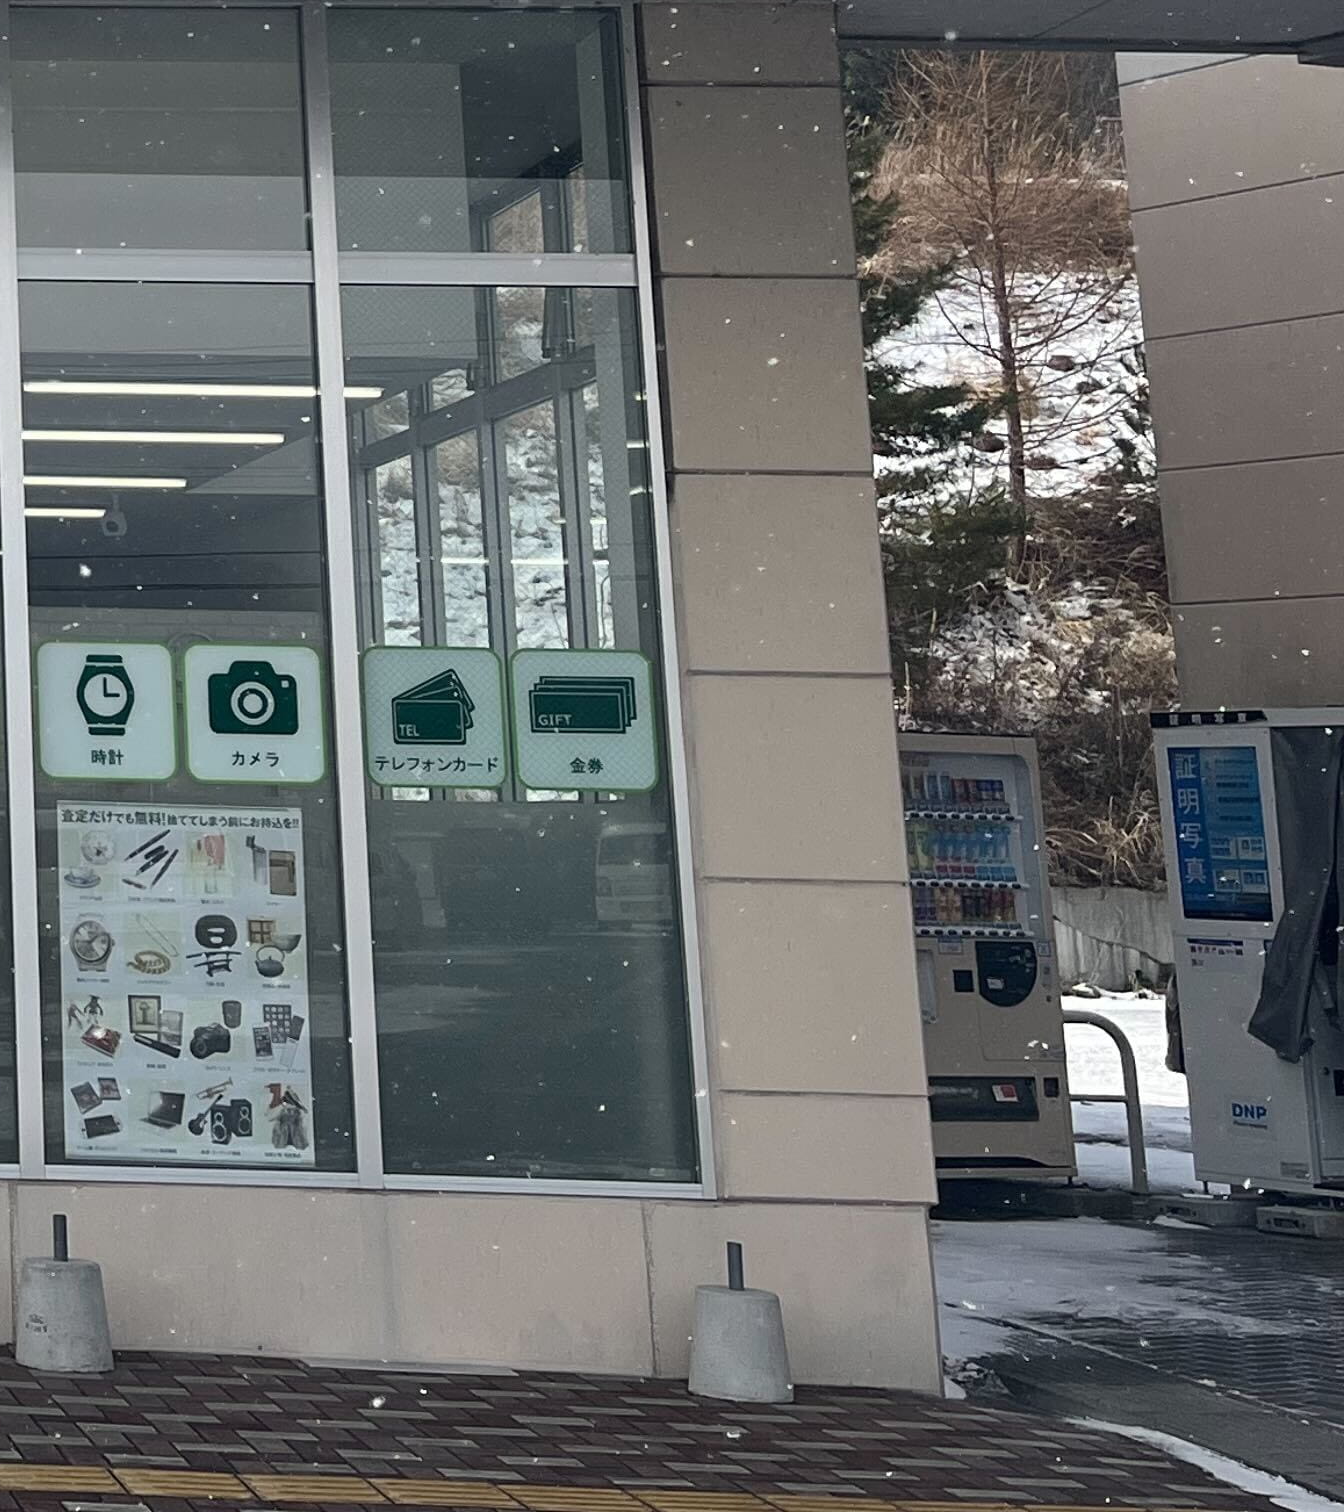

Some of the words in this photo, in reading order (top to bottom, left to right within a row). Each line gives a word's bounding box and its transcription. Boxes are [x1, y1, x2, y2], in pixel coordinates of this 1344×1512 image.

[537, 714, 572, 726] GIFT
[399, 723, 420, 737] TEL
[91, 749, 124, 766] 時計
[231, 751, 280, 767] カメラ
[375, 756, 498, 773] テレフォンカード
[570, 757, 604, 774] 金券
[1173, 752, 1206, 885] 証明写真
[1232, 1103, 1267, 1119] DNP
